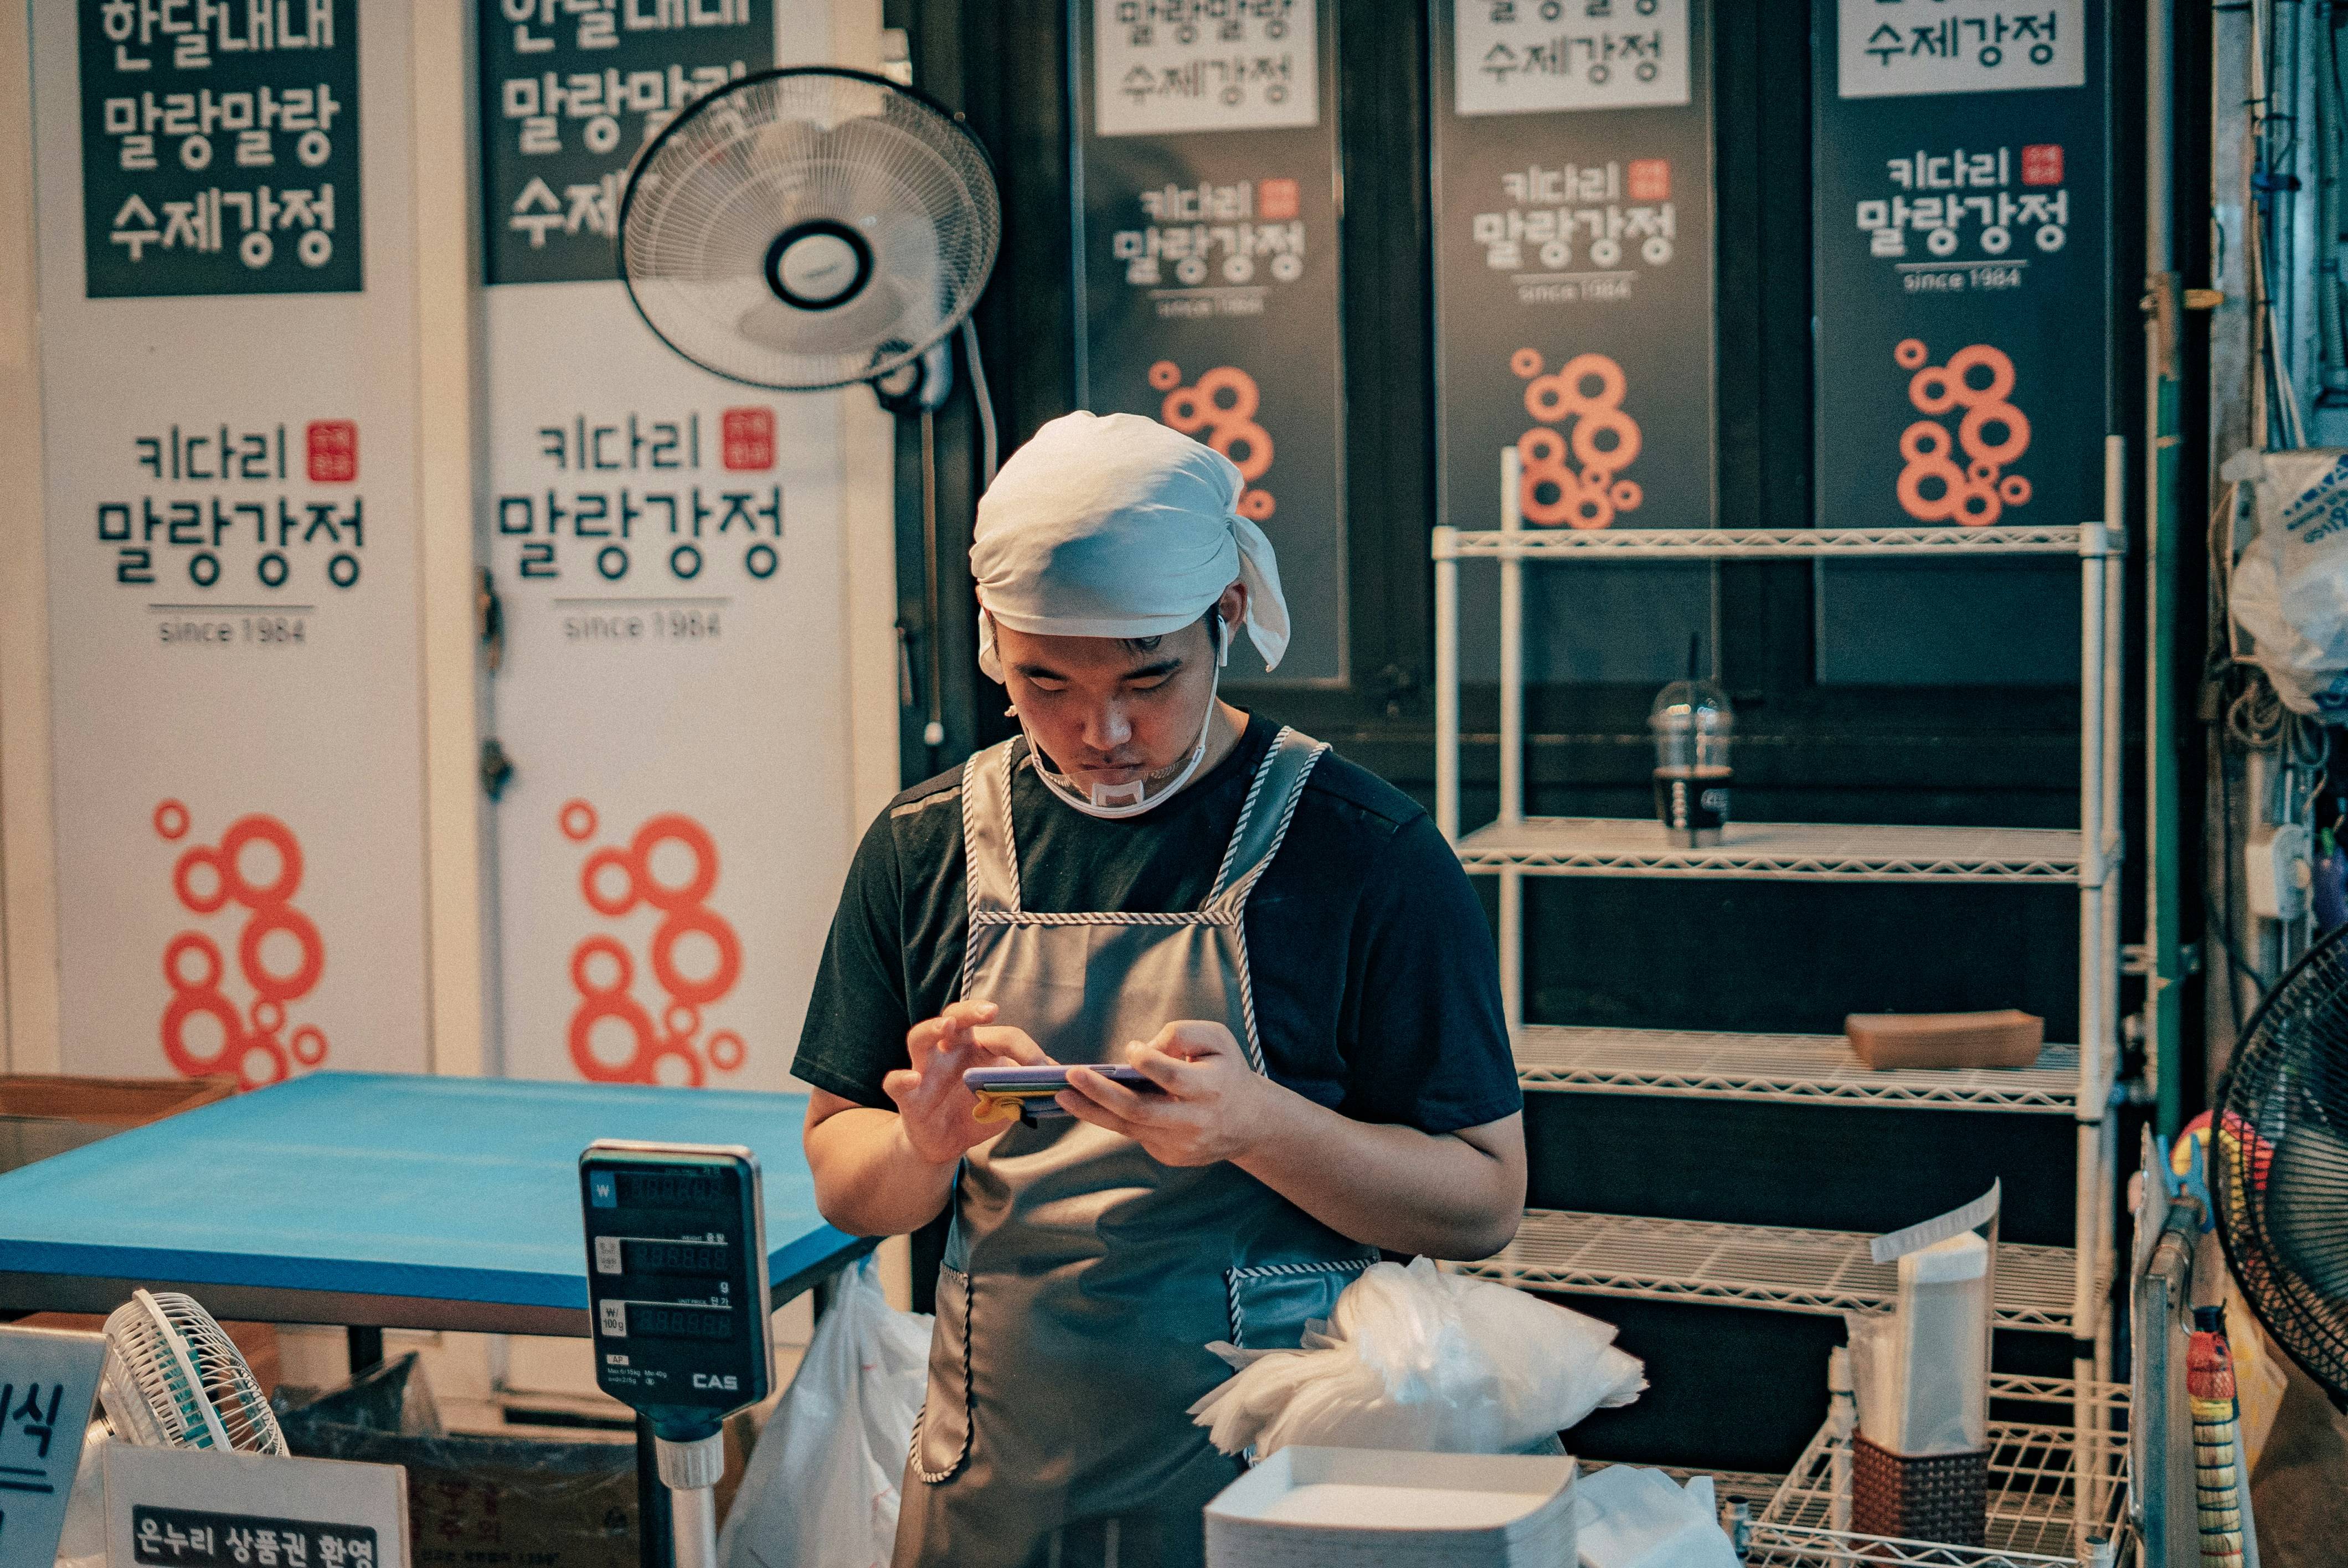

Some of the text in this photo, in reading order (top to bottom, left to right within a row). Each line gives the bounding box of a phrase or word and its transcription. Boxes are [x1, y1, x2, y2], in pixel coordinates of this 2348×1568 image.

[102, 0, 334, 71] 한달내내
[1482, 30, 1660, 84] 수제강정
[1865, 11, 2056, 68] 수제강정
[1121, 54, 1292, 106] 수제강정
[104, 84, 341, 170] 말랑말랑
[1501, 161, 1621, 203] 키다리
[1887, 147, 2011, 190] 키다리
[110, 184, 334, 269] 수제강정
[1140, 181, 1253, 222] 키다리
[1856, 190, 2069, 257] 말랑강정
[1113, 220, 1306, 285] 말랑강정
[1473, 203, 1676, 270] 말랑강정
[1903, 269, 2021, 293] since 1984
[136, 424, 287, 479] 키다리
[539, 413, 699, 470] 키다리
[99, 496, 363, 588] 말랑강정
[500, 486, 783, 580] 말랑강정
[159, 617, 306, 643] since 1984
[564, 610, 721, 639] since 1984
[693, 1373, 738, 1390] CAS
[0, 1383, 64, 1458] 식
[137, 1517, 215, 1556] 온누리
[225, 1526, 307, 1566] 상품권
[318, 1534, 373, 1568] 환영
